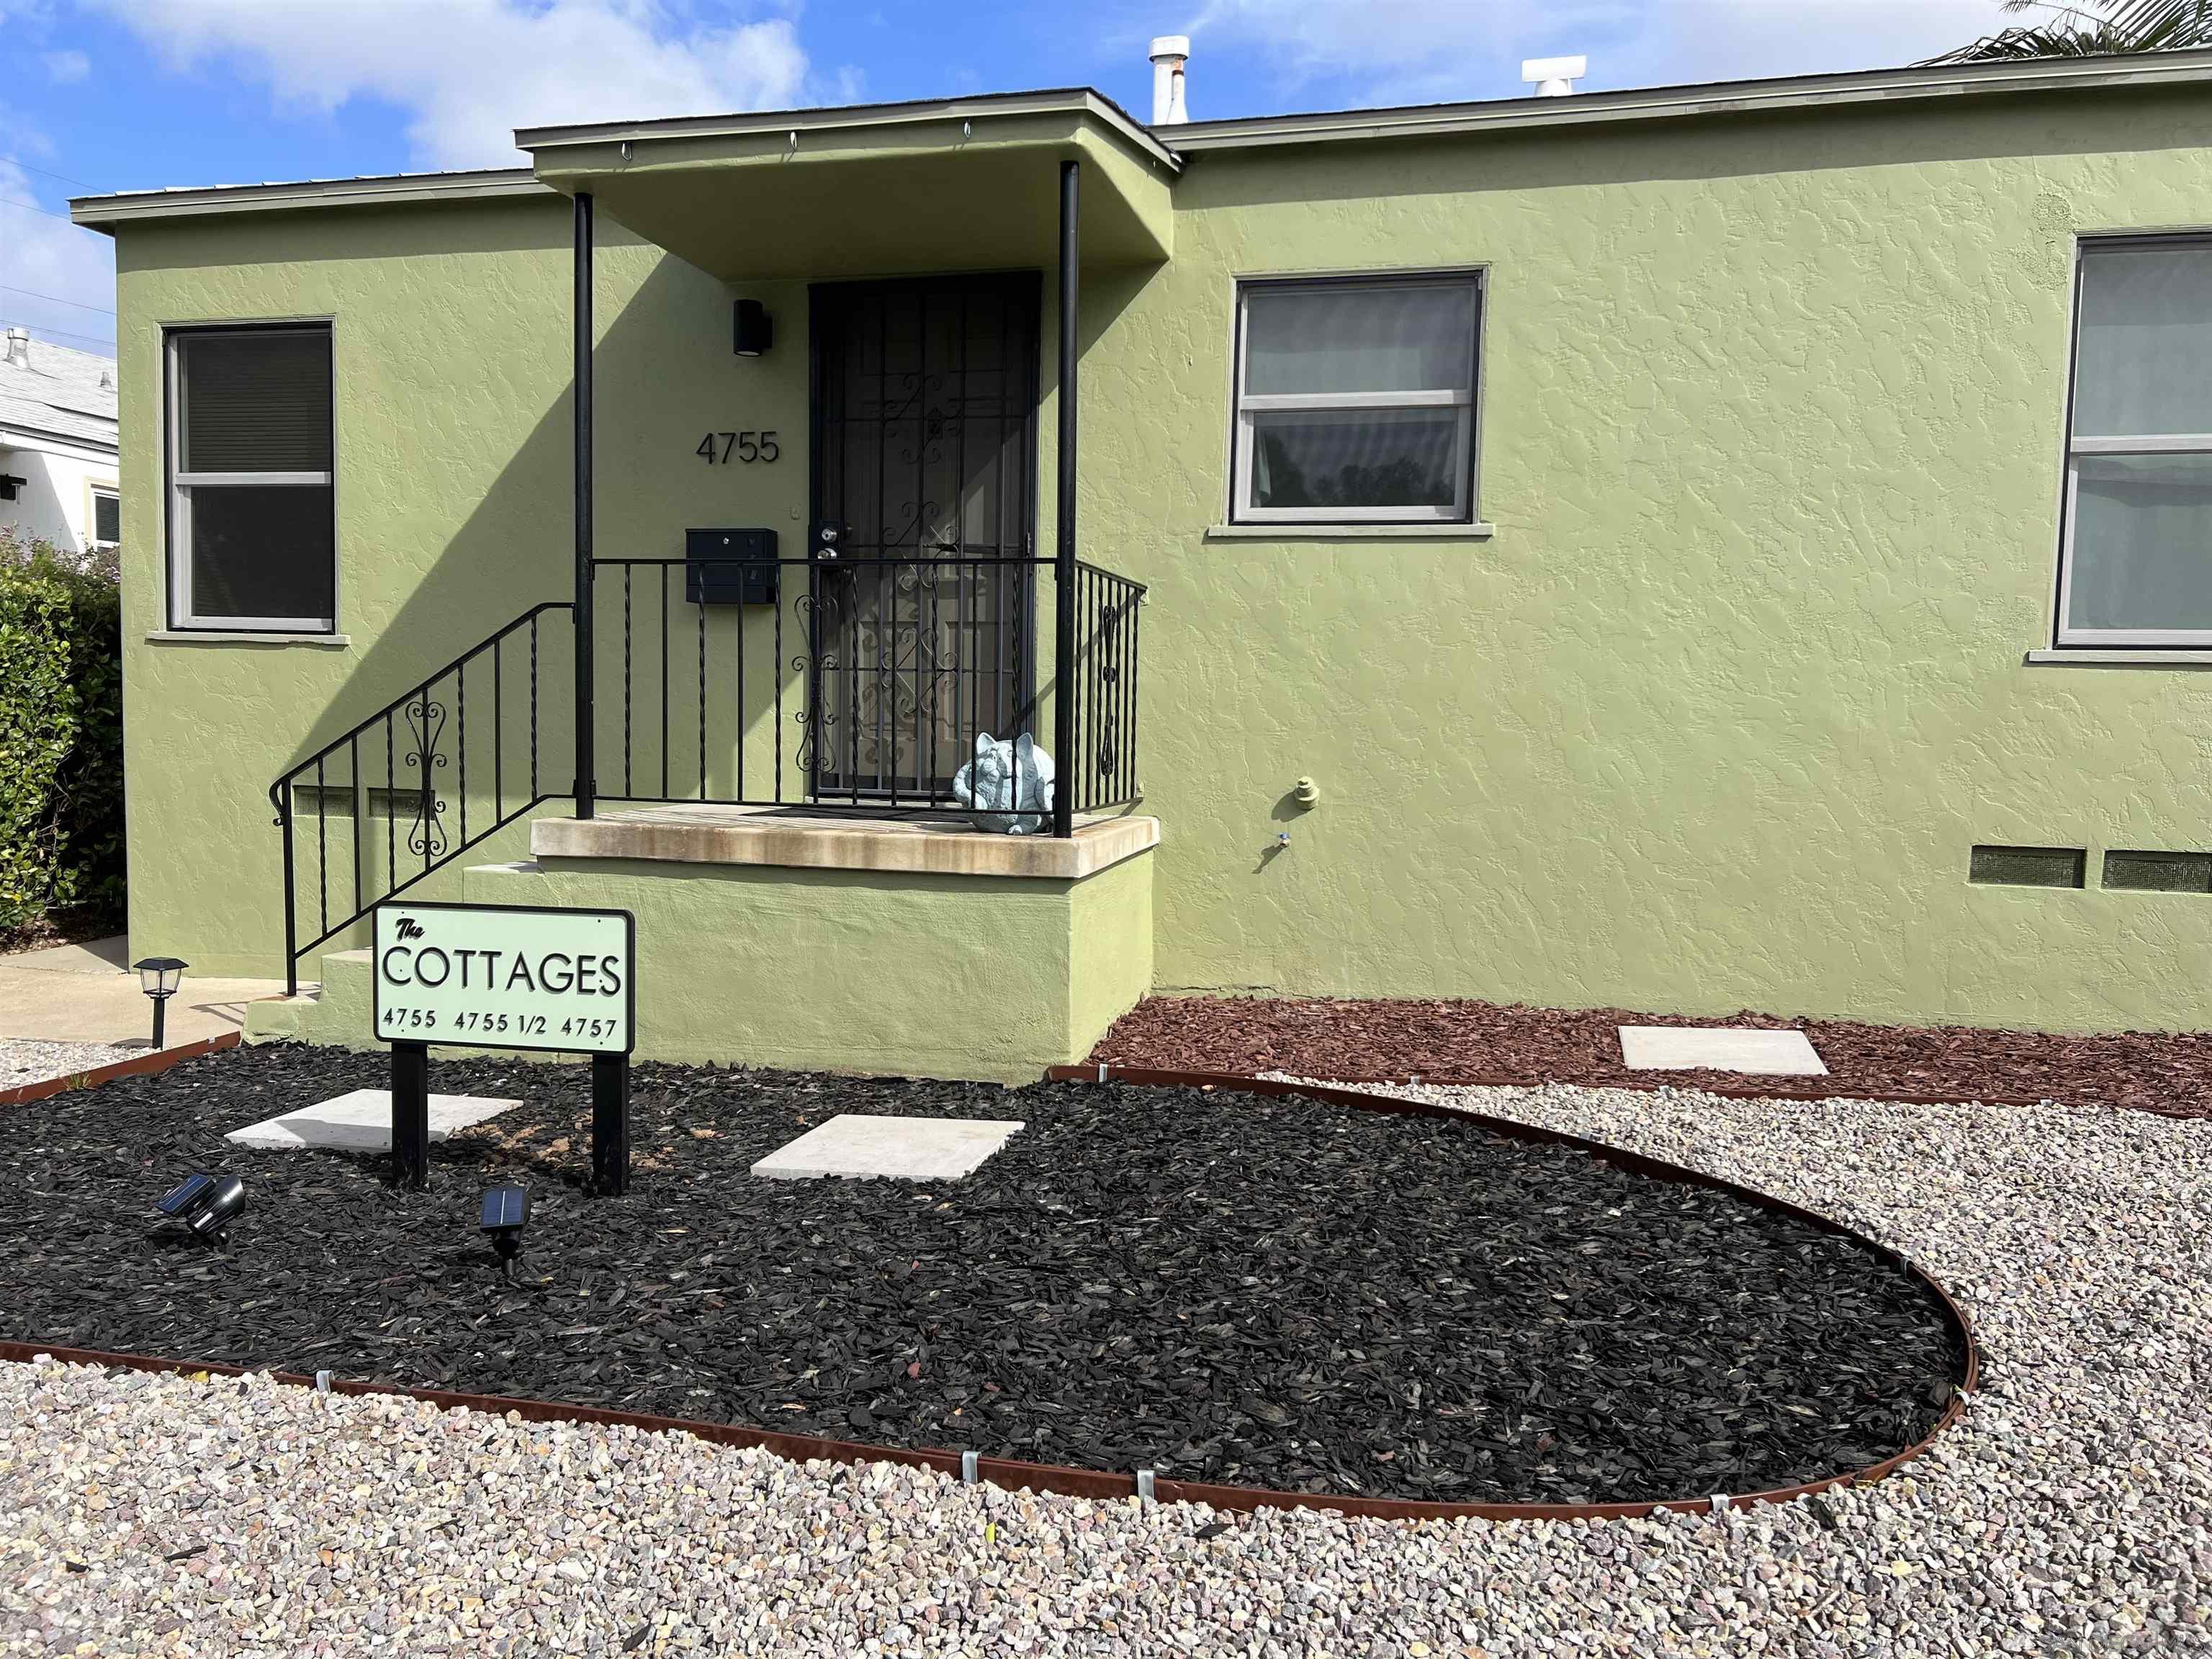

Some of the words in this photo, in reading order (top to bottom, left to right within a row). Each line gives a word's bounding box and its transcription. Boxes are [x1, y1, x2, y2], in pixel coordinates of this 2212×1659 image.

[696, 431, 779, 464] 4755
[395, 917, 426, 941] The
[382, 945, 621, 997] COTTAGES
[384, 1007, 436, 1028] 4755
[454, 1012, 508, 1032] 4755
[518, 1015, 546, 1035] 1/2
[562, 1017, 617, 1038] 4757
